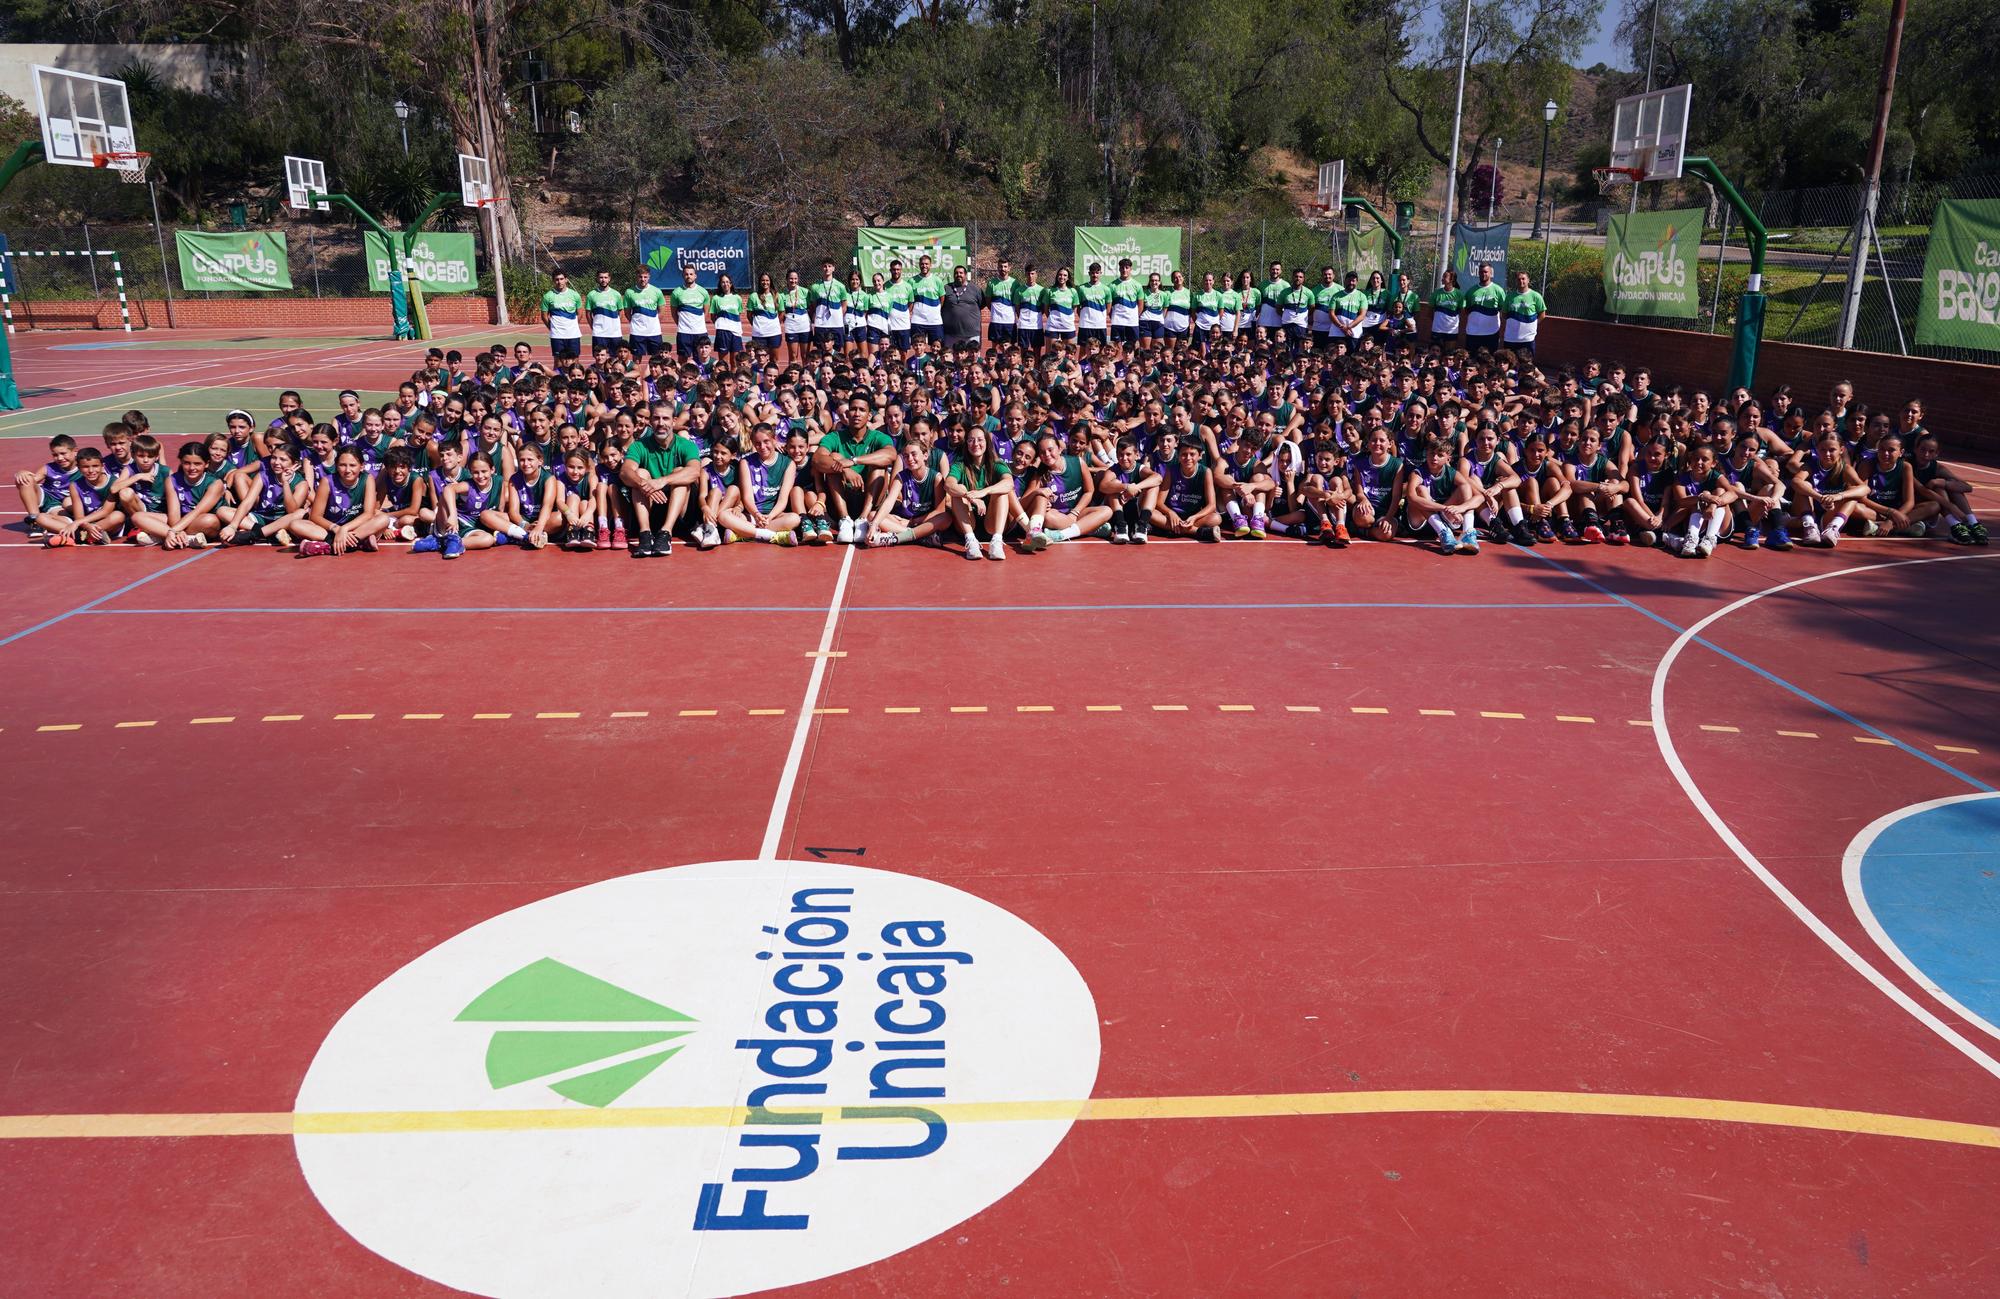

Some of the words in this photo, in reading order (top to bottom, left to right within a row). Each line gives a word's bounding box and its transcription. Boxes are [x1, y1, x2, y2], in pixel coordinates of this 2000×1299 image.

[676, 246, 744, 259] Fundación
[1613, 289, 1655, 300] FUNDACIÓN
[1656, 290, 1686, 303] UNICAJA
[692, 888, 854, 1230] Fundación
[836, 920, 974, 1160] Unicaja
